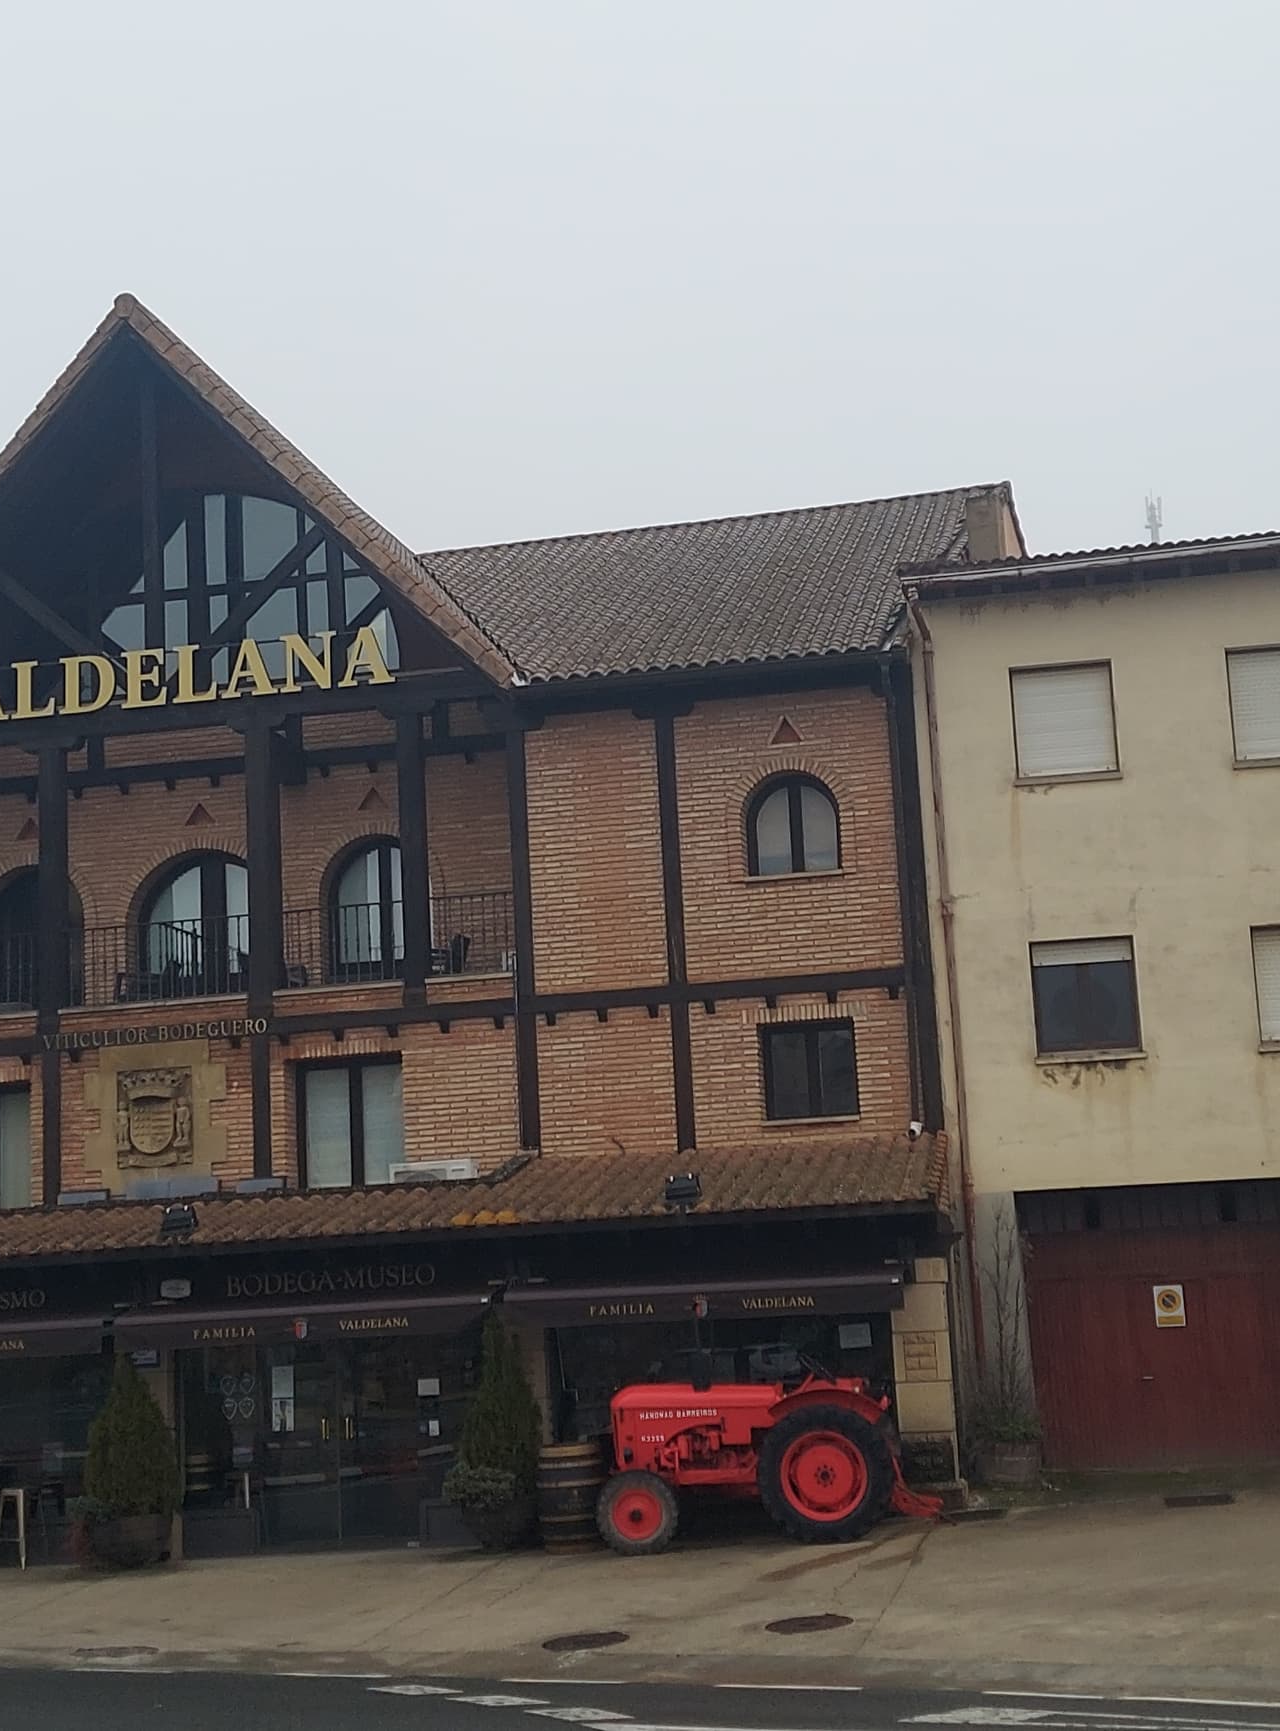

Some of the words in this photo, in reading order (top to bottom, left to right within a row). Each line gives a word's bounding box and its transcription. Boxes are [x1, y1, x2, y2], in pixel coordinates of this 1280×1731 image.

[588, 1303, 655, 1317] FAMILIA
[741, 1296, 816, 1311] VALDELANA
[192, 1326, 257, 1340] FAMILIA
[339, 1316, 410, 1331] VALDELANA
